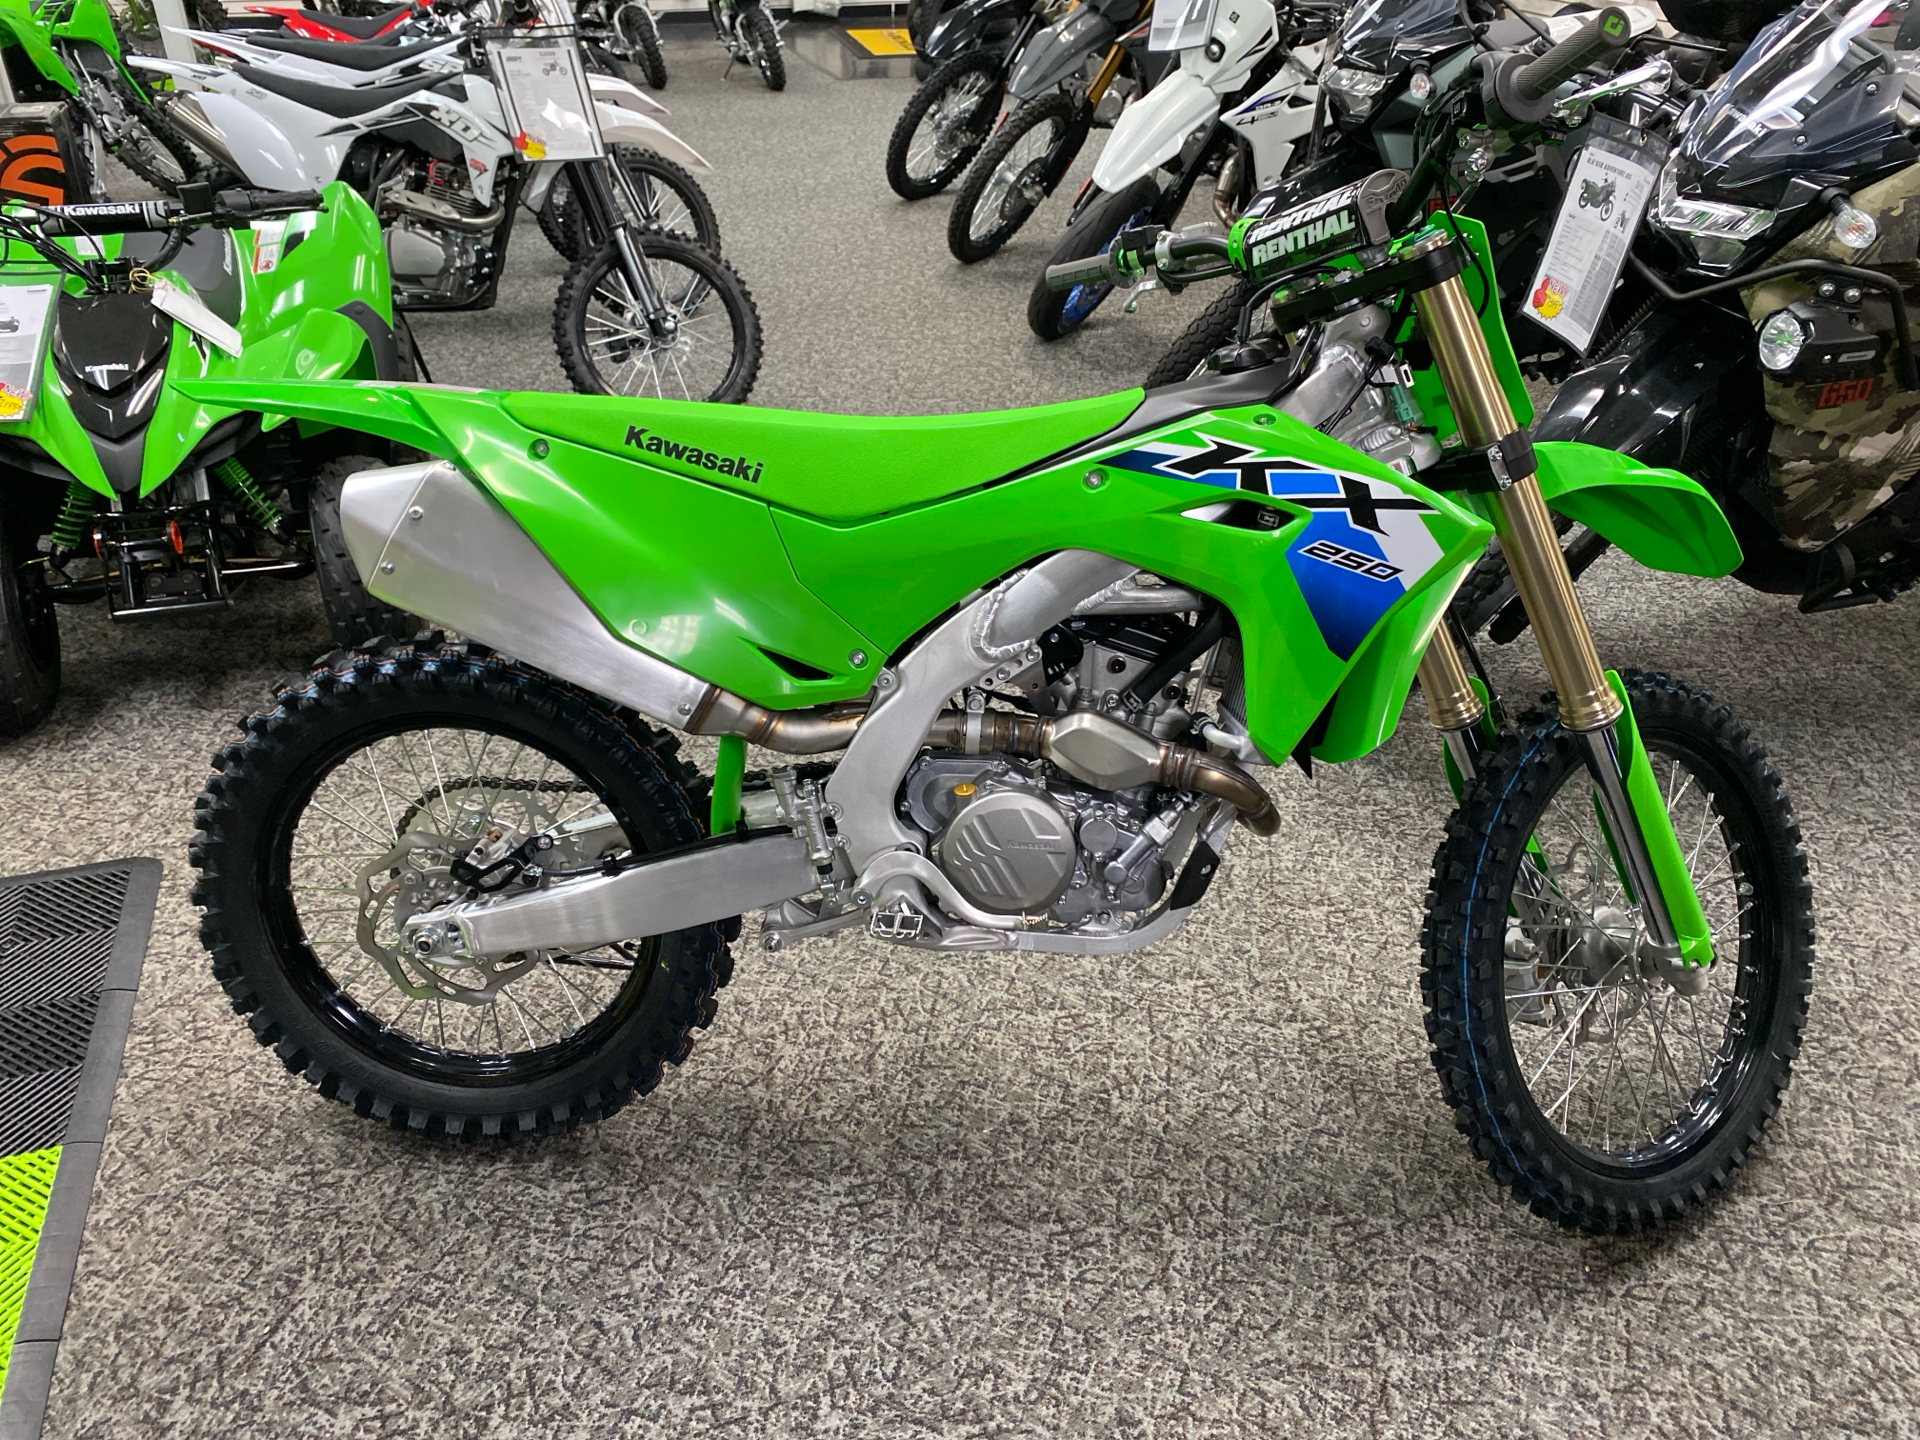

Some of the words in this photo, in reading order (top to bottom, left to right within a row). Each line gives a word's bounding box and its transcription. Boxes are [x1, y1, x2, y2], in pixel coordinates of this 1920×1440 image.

[63, 203, 140, 216] Kawasaki
[1252, 209, 1356, 267] RENTHAL
[1816, 377, 1875, 409] 650
[624, 424, 764, 484] Kawasaki
[1163, 438, 1435, 537] KX
[1299, 540, 1404, 581] 250
